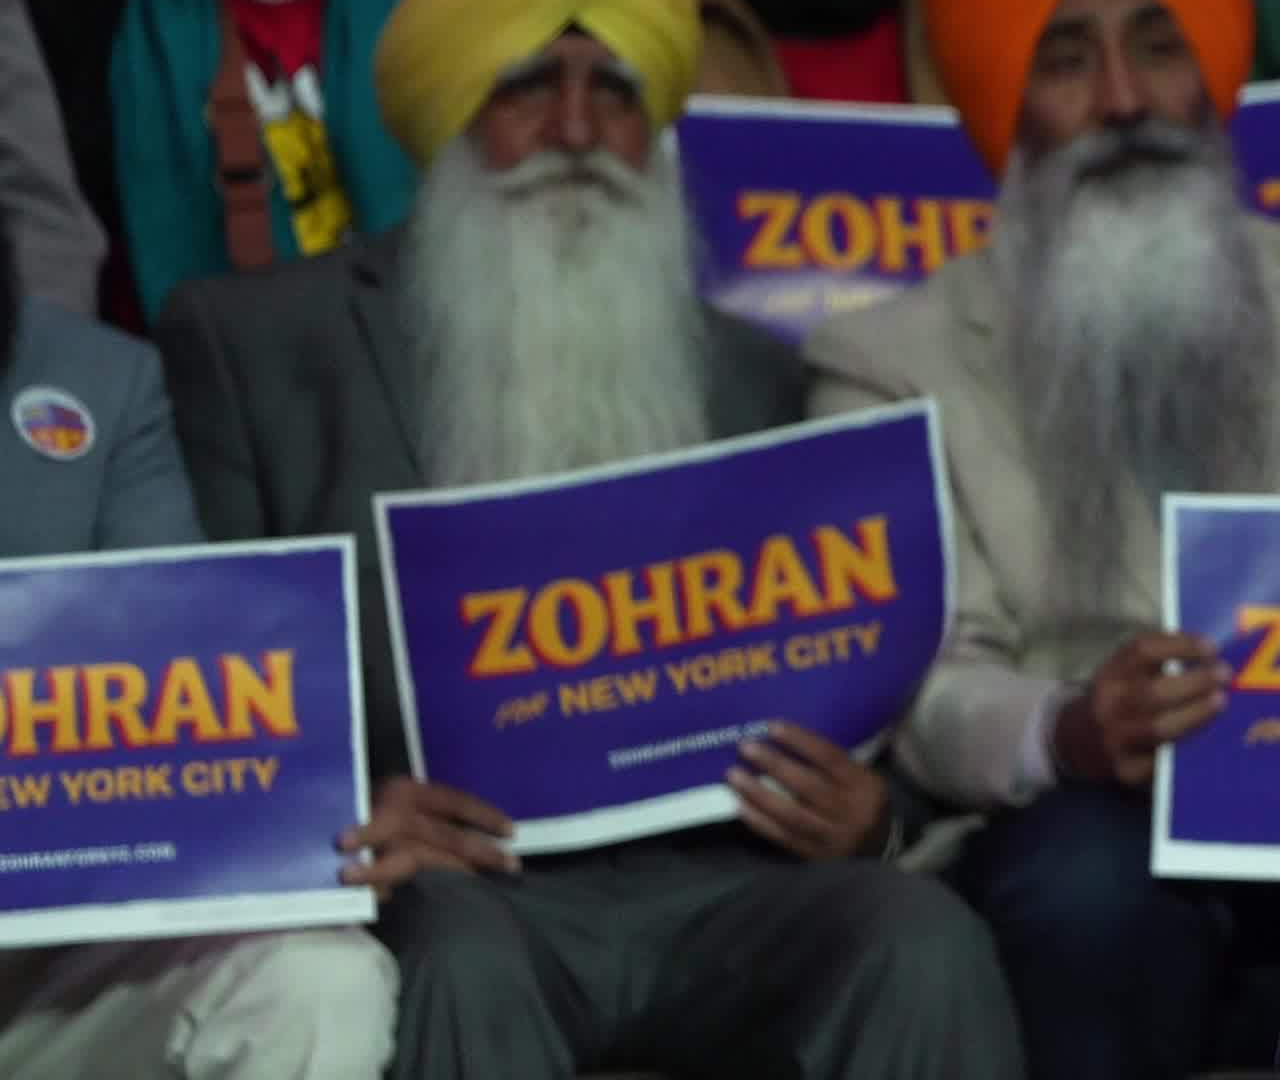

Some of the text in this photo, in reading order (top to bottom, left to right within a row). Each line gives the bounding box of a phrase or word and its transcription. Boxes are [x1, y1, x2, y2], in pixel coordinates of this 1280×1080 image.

[458, 514, 899, 680] ZOHRAN
[0, 647, 299, 760] HRAN
[558, 665, 657, 718] NEW
[665, 638, 778, 695] YORK
[784, 622, 883, 672] CITY
[59, 764, 176, 807] YORK
[181, 755, 280, 799] CITY
